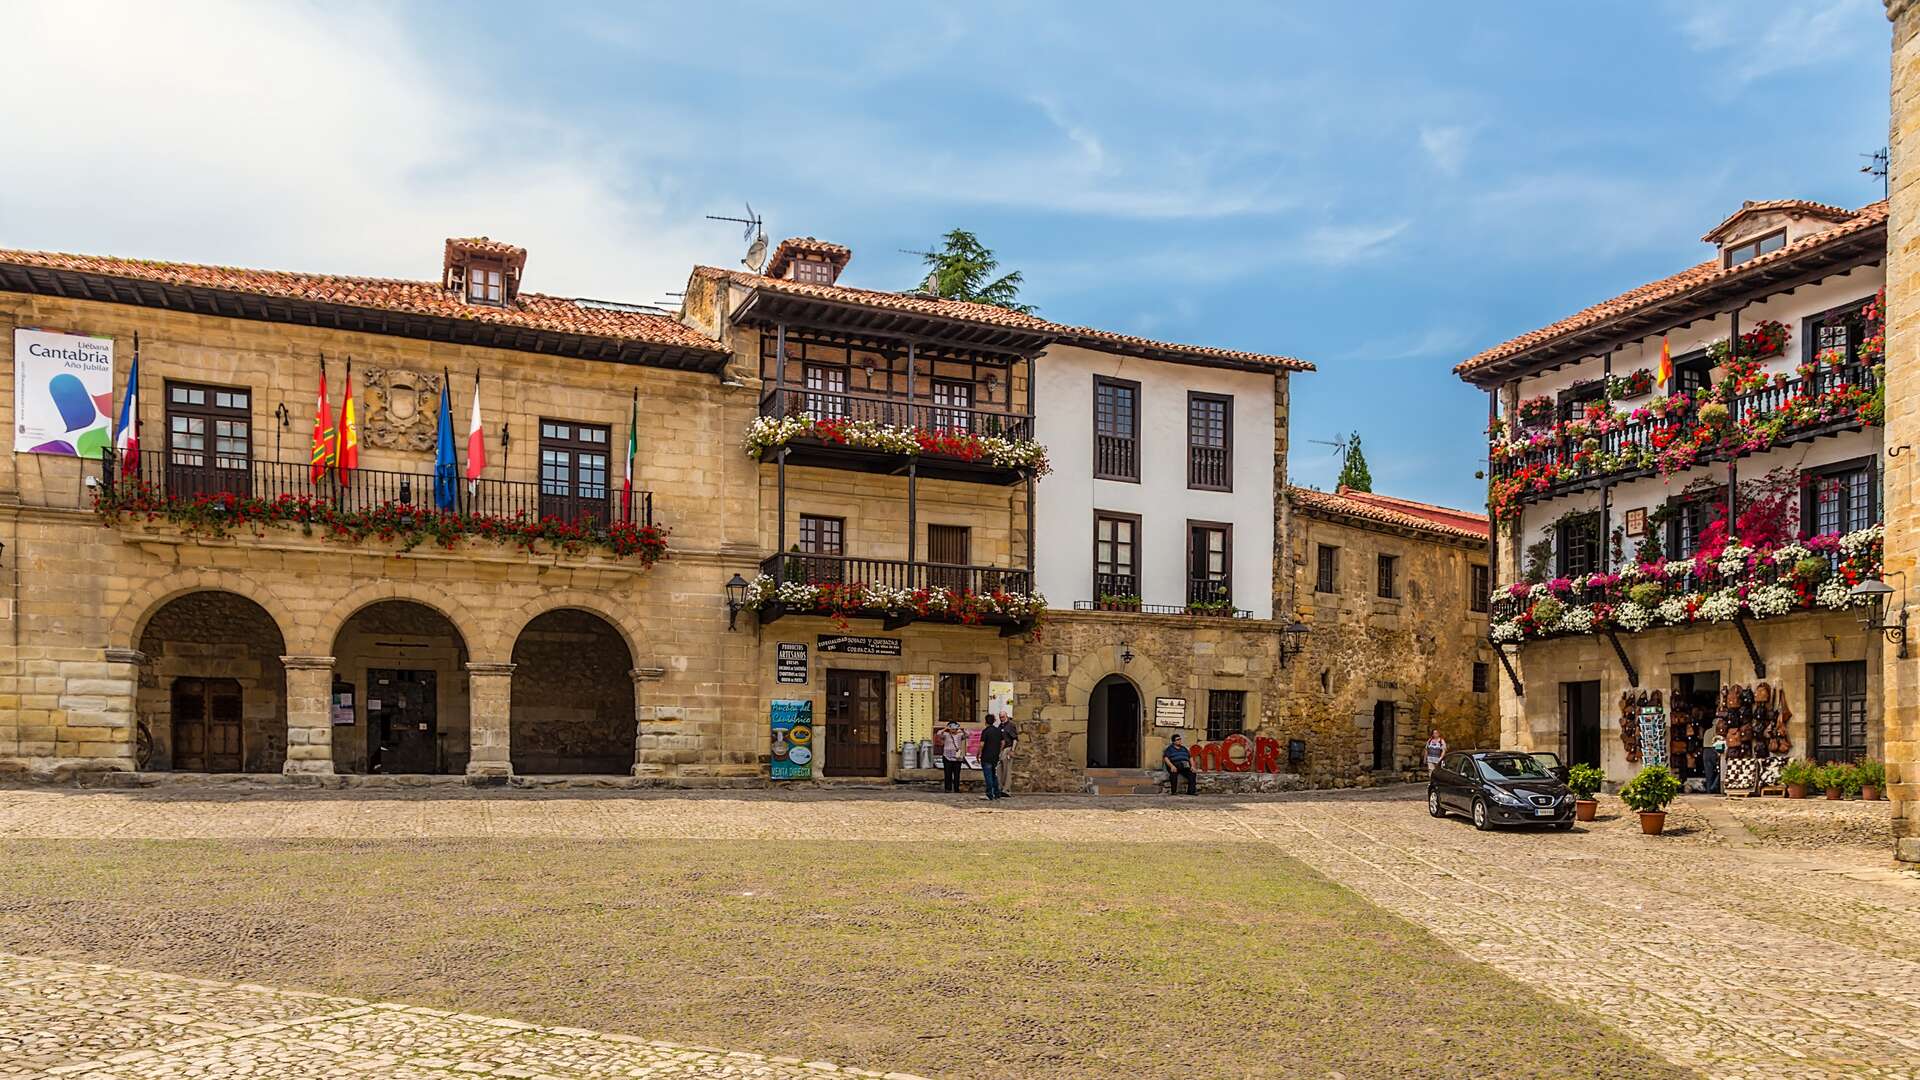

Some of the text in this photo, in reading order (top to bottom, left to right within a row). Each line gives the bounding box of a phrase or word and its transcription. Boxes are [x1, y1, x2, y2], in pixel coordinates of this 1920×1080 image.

[29, 343, 109, 364] Cantabria
[64, 361, 109, 371] Año Jubilar
[779, 650, 806, 660] ARTESANOS
